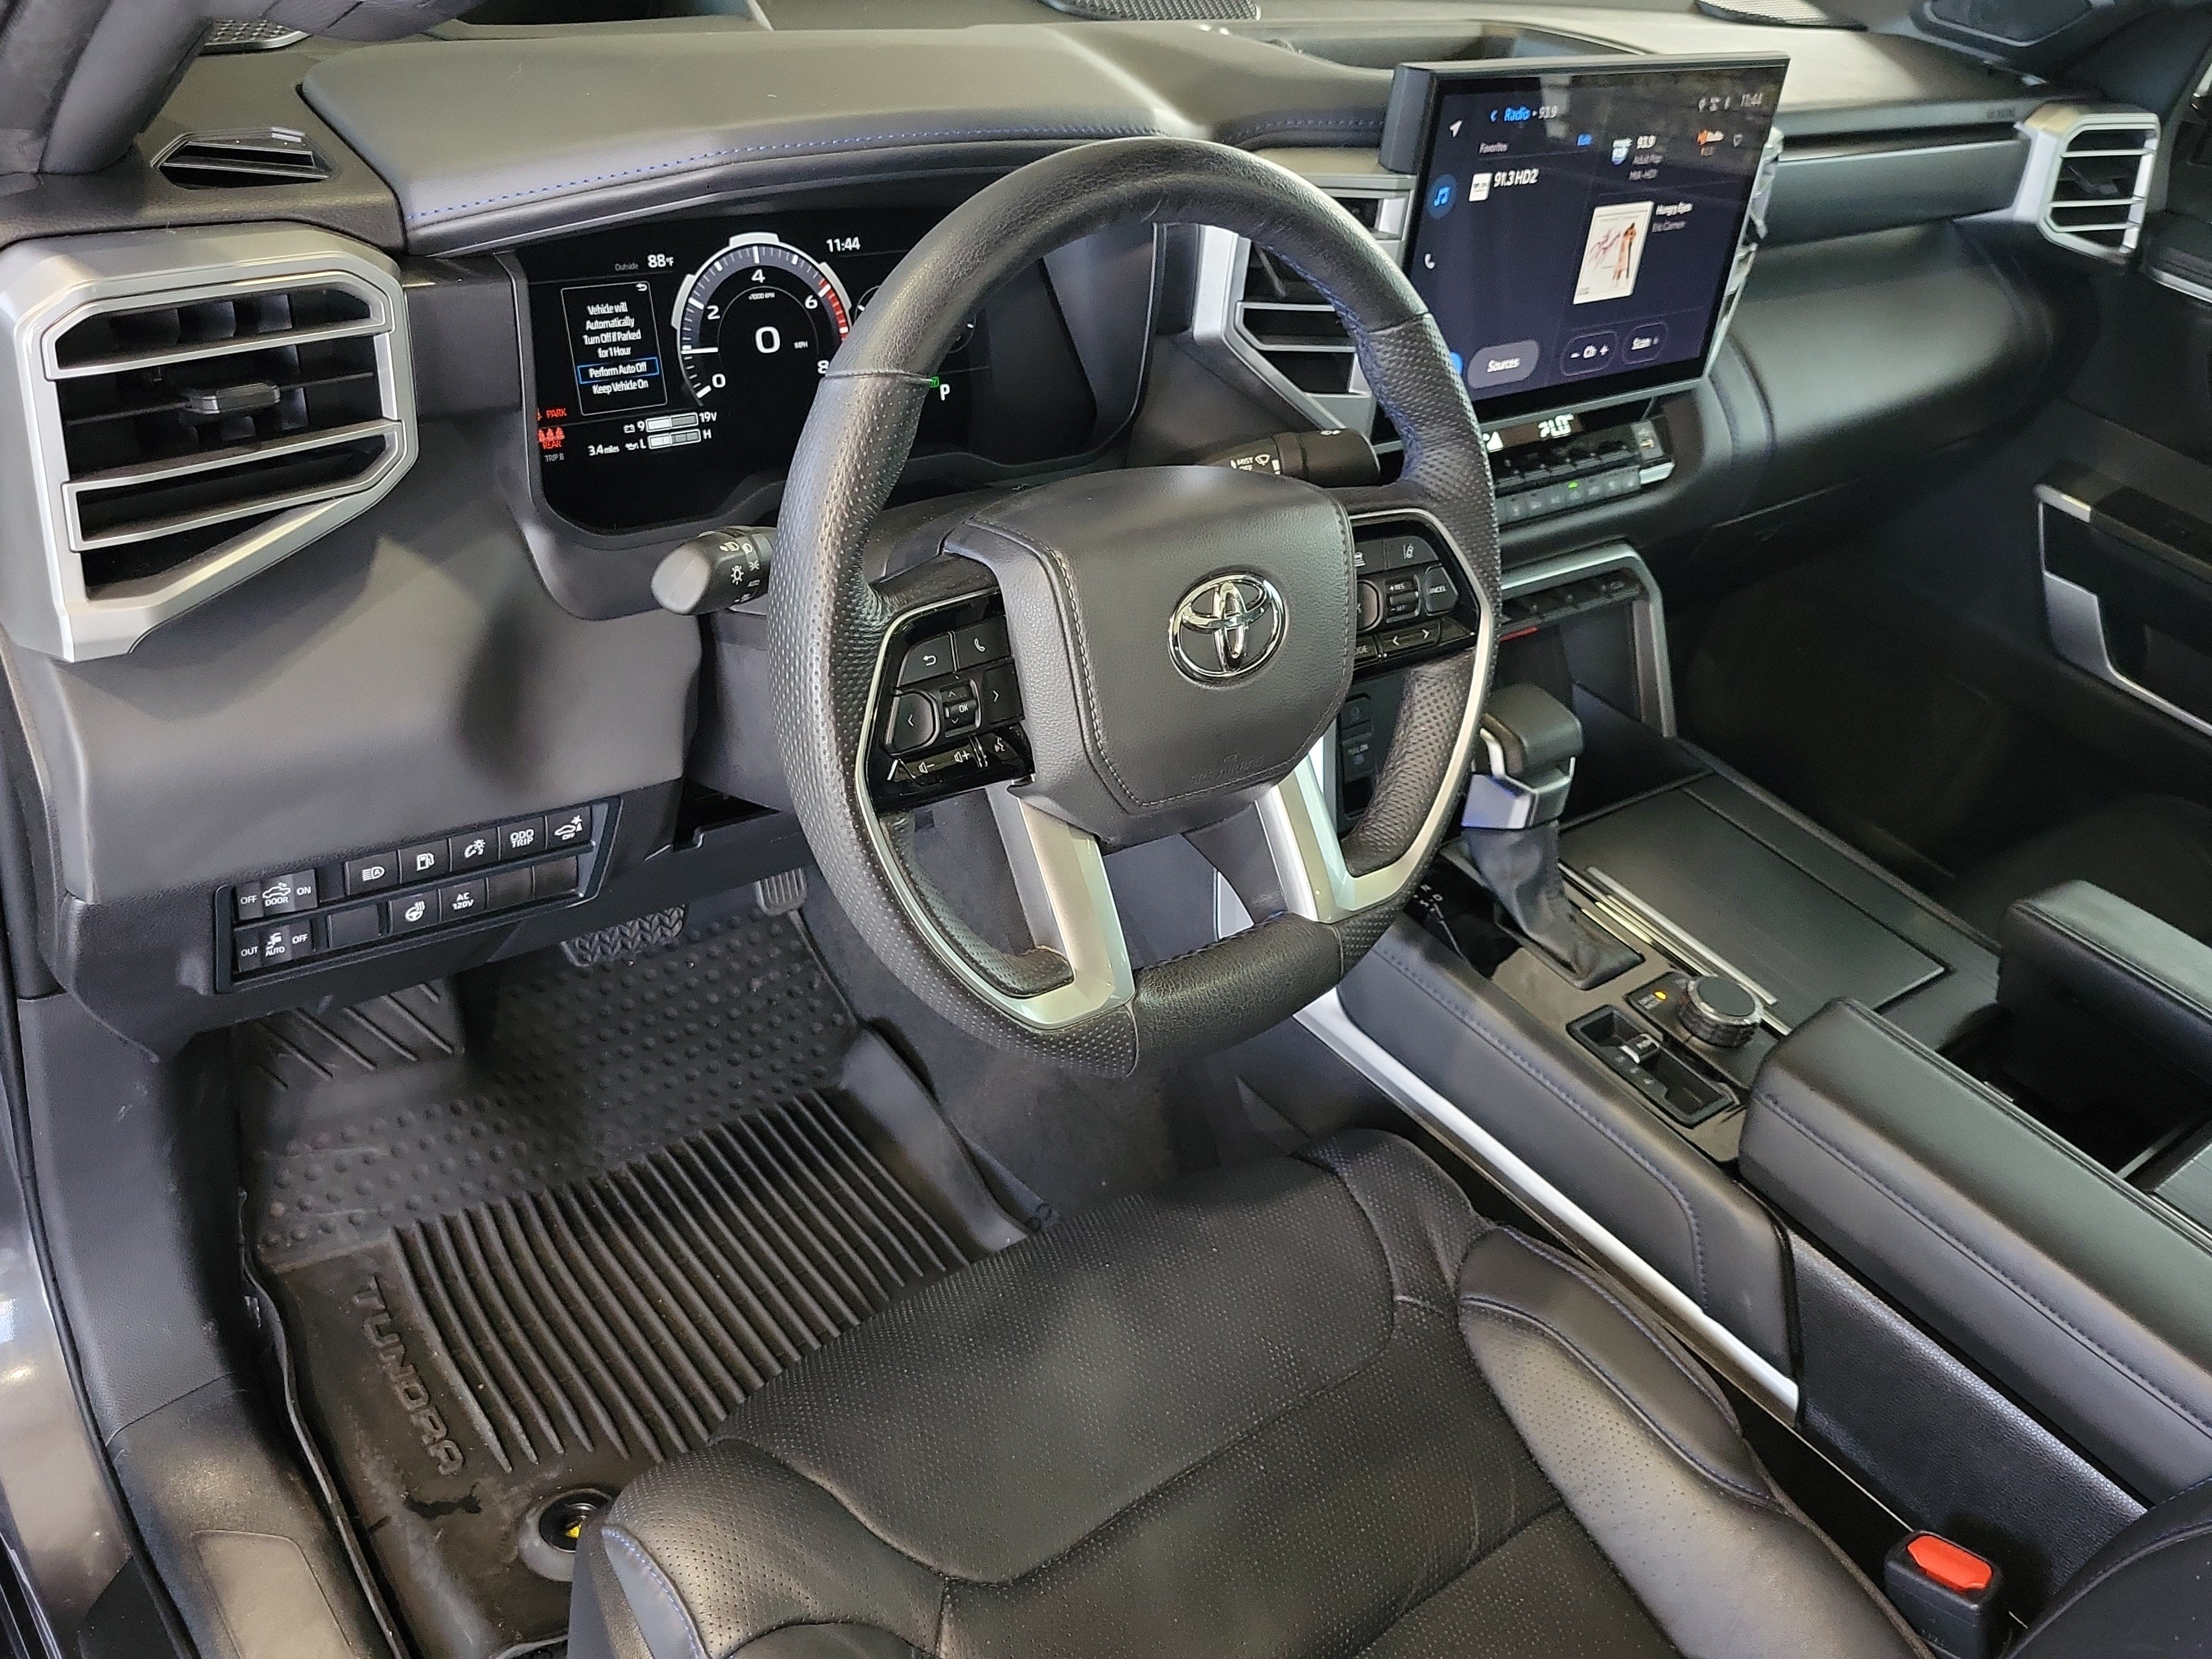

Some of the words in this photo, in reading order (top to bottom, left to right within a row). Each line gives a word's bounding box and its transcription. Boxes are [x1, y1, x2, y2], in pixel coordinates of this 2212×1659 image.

[1504, 107, 1531, 121] Radio
[1493, 170, 1515, 188] 91.3
[1514, 168, 1539, 185] HD2
[826, 236, 861, 253] 11:44
[615, 261, 639, 272] Outside
[751, 269, 765, 284] 4
[587, 303, 614, 315] Vehicle
[613, 301, 629, 313] will
[804, 295, 818, 309] 6
[707, 305, 721, 320] 2
[585, 315, 635, 330] Automatically
[582, 335, 601, 345] Turn
[600, 331, 612, 343] Off
[611, 331, 617, 342] if
[617, 328, 642, 342] Parked
[755, 326, 781, 355] 0
[597, 347, 609, 358] for
[608, 347, 613, 357] 1
[613, 346, 631, 357] Hour
[588, 366, 619, 379] Perform
[618, 364, 636, 375] Auto
[635, 362, 647, 373] Off
[817, 360, 829, 374] 8
[1487, 357, 1521, 374] Sources
[592, 383, 612, 396] Keep
[611, 379, 637, 392] Vehicle
[637, 379, 649, 389] On
[712, 373, 726, 388] 0
[939, 384, 951, 401] P
[545, 408, 568, 419] PARK
[637, 420, 645, 432] 9
[699, 411, 718, 424] 19V
[542, 439, 562, 450] REAR
[639, 438, 647, 449] L
[702, 429, 712, 439] H
[544, 454, 558, 463] TRIP
[560, 453, 565, 461] B
[958, 704, 969, 713] OK
[510, 828, 535, 841] ODO
[562, 832, 576, 840] OFF
[511, 837, 534, 849] TRIP
[240, 895, 257, 905] OFF
[296, 885, 312, 896] ON
[264, 896, 289, 907] DOOR
[456, 891, 471, 902] AC
[452, 899, 475, 911] 120V
[241, 946, 259, 957] OUT
[292, 933, 309, 945] OFF
[264, 946, 285, 958] AUTO
[351, 1274, 465, 1476] TUNDRA
